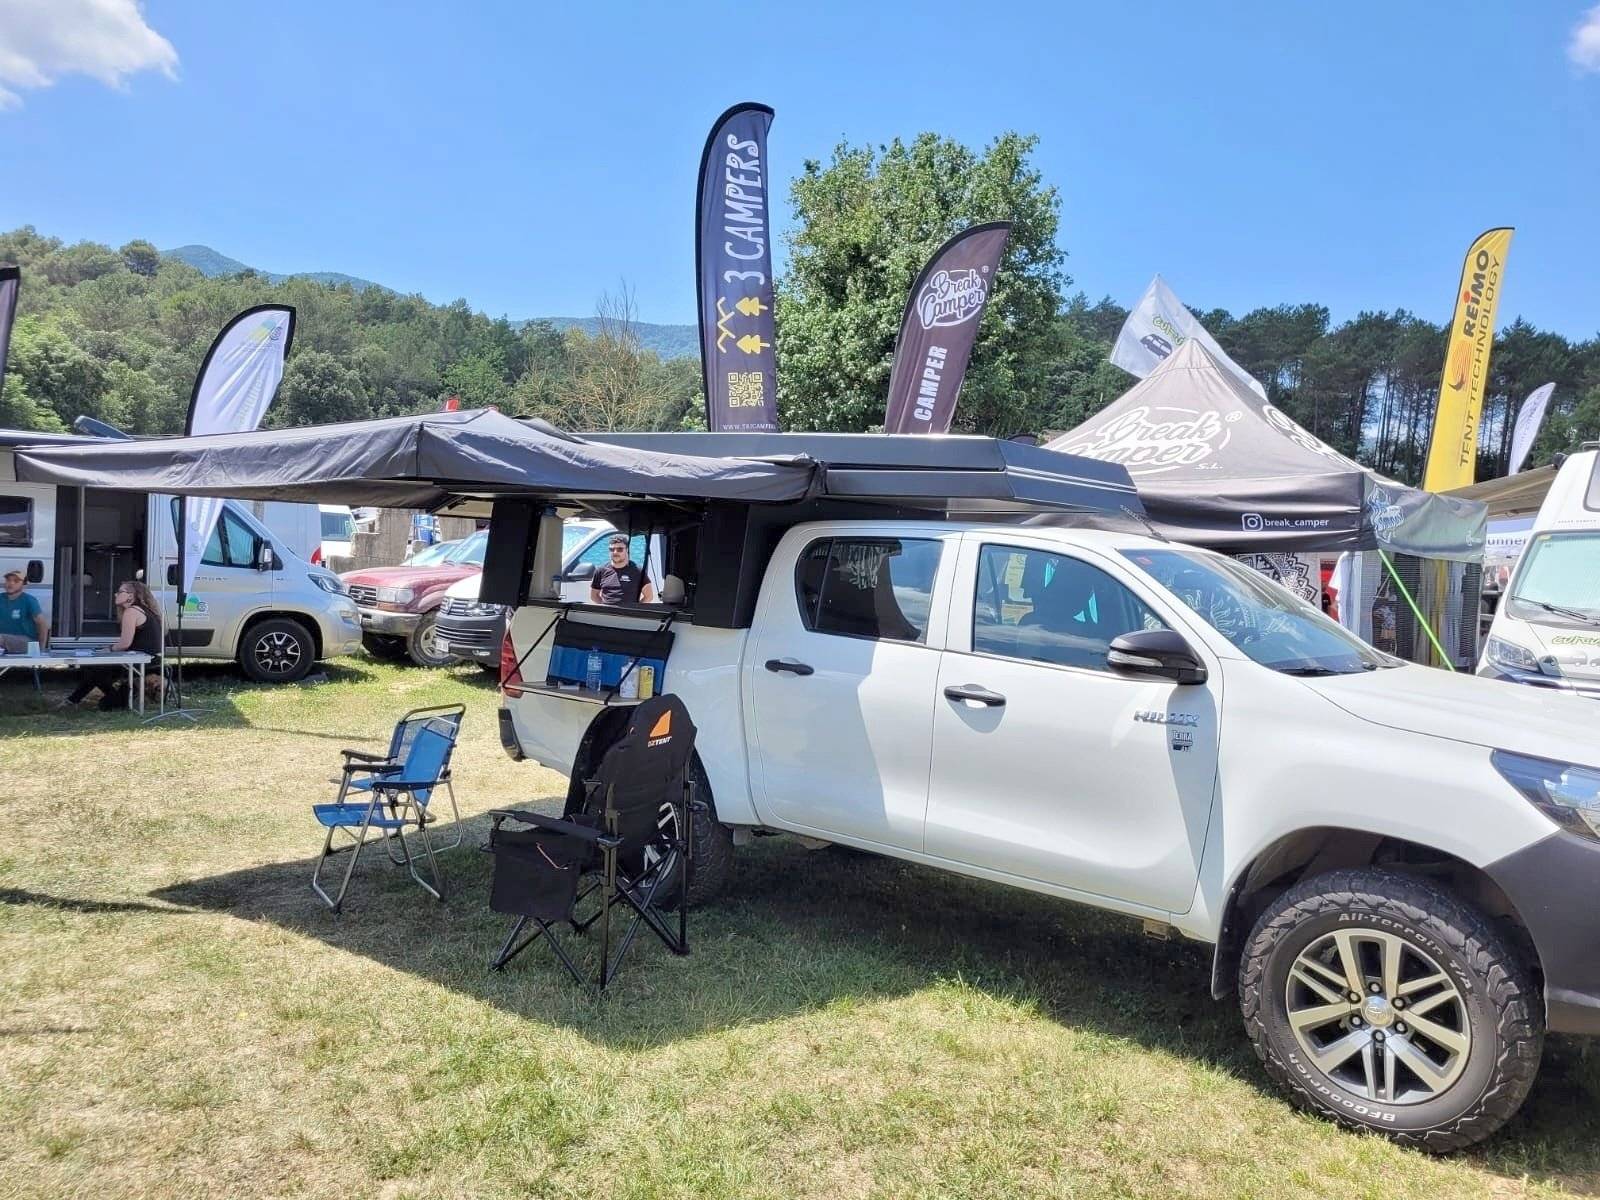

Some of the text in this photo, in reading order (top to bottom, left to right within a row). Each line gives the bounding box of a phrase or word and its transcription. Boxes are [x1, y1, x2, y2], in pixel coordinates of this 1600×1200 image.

[724, 134, 765, 285] 3 CAMPERS
[920, 288, 985, 329] Camper
[930, 269, 981, 301] Break
[913, 346, 948, 421] CAMPER
[1460, 256, 1500, 466] TENT TECHNOLOGY
[1097, 406, 1222, 443] Break
[1264, 518, 1330, 528] break_camper
[1338, 912, 1473, 989] All-Terrain T/A
[1288, 1053, 1396, 1122] BFGoodrich
